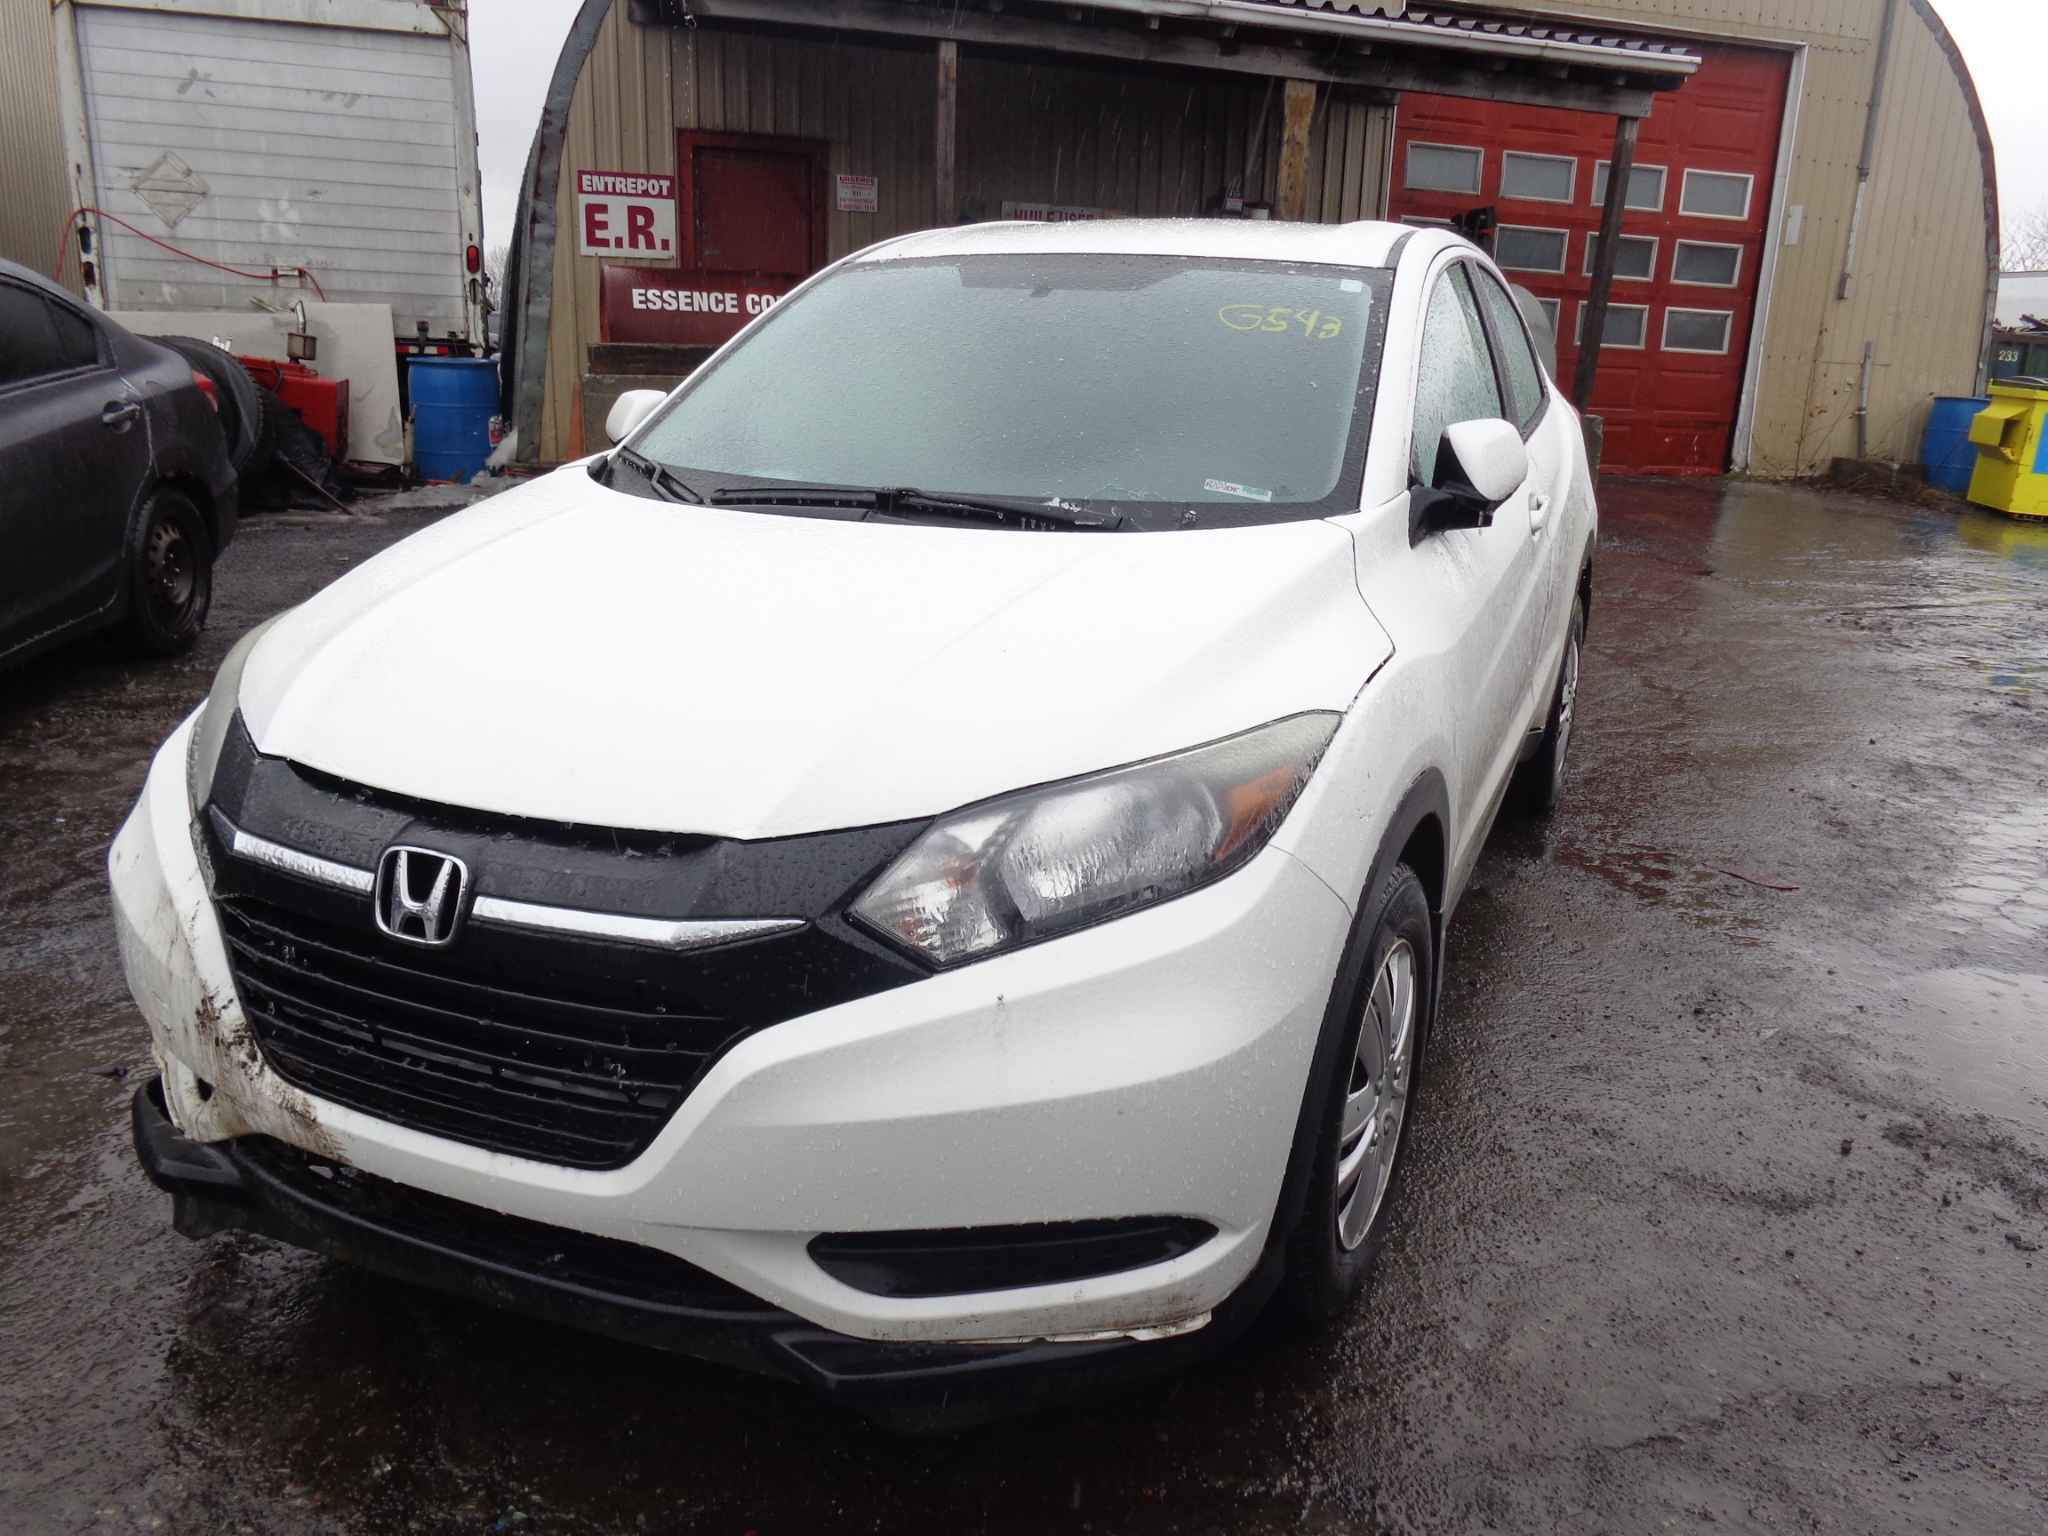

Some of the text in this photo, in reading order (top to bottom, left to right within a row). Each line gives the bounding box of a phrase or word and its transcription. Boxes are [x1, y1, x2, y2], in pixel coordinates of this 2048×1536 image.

[582, 174, 670, 196] ENTREPOT
[585, 203, 670, 251] E.R.
[632, 288, 783, 315] ESSENCE CO
